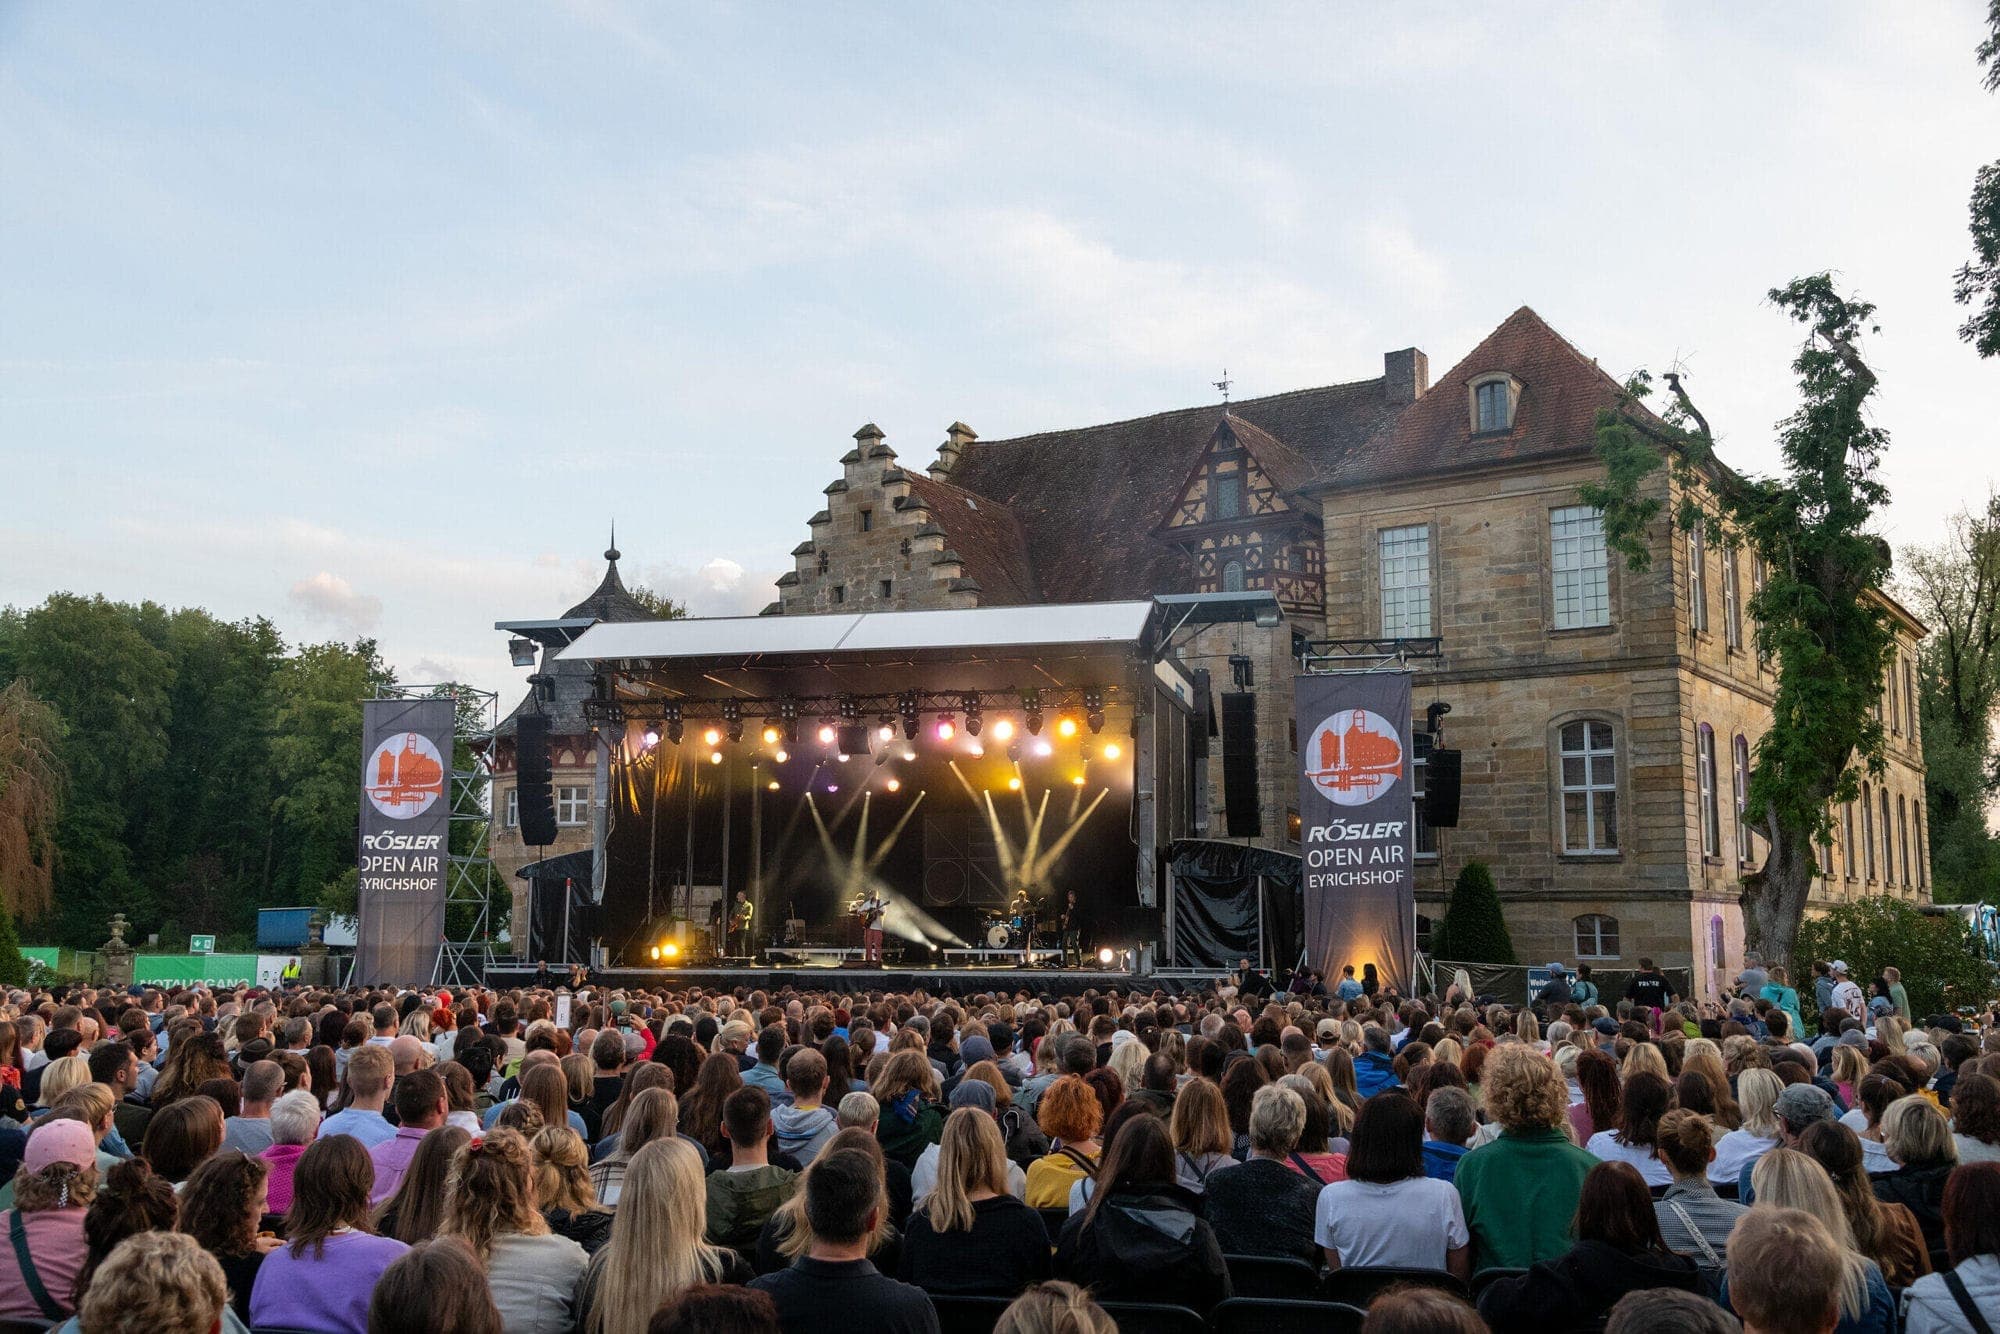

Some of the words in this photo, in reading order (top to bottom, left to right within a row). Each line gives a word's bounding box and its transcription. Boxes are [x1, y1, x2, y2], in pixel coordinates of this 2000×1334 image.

[410, 856, 439, 872] AIR
[1308, 847, 1363, 867] OPEN
[1369, 845, 1404, 864] AIR
[1309, 870, 1404, 888] EYRICHSHOF
[139, 978, 250, 990] NOTAUGAN
